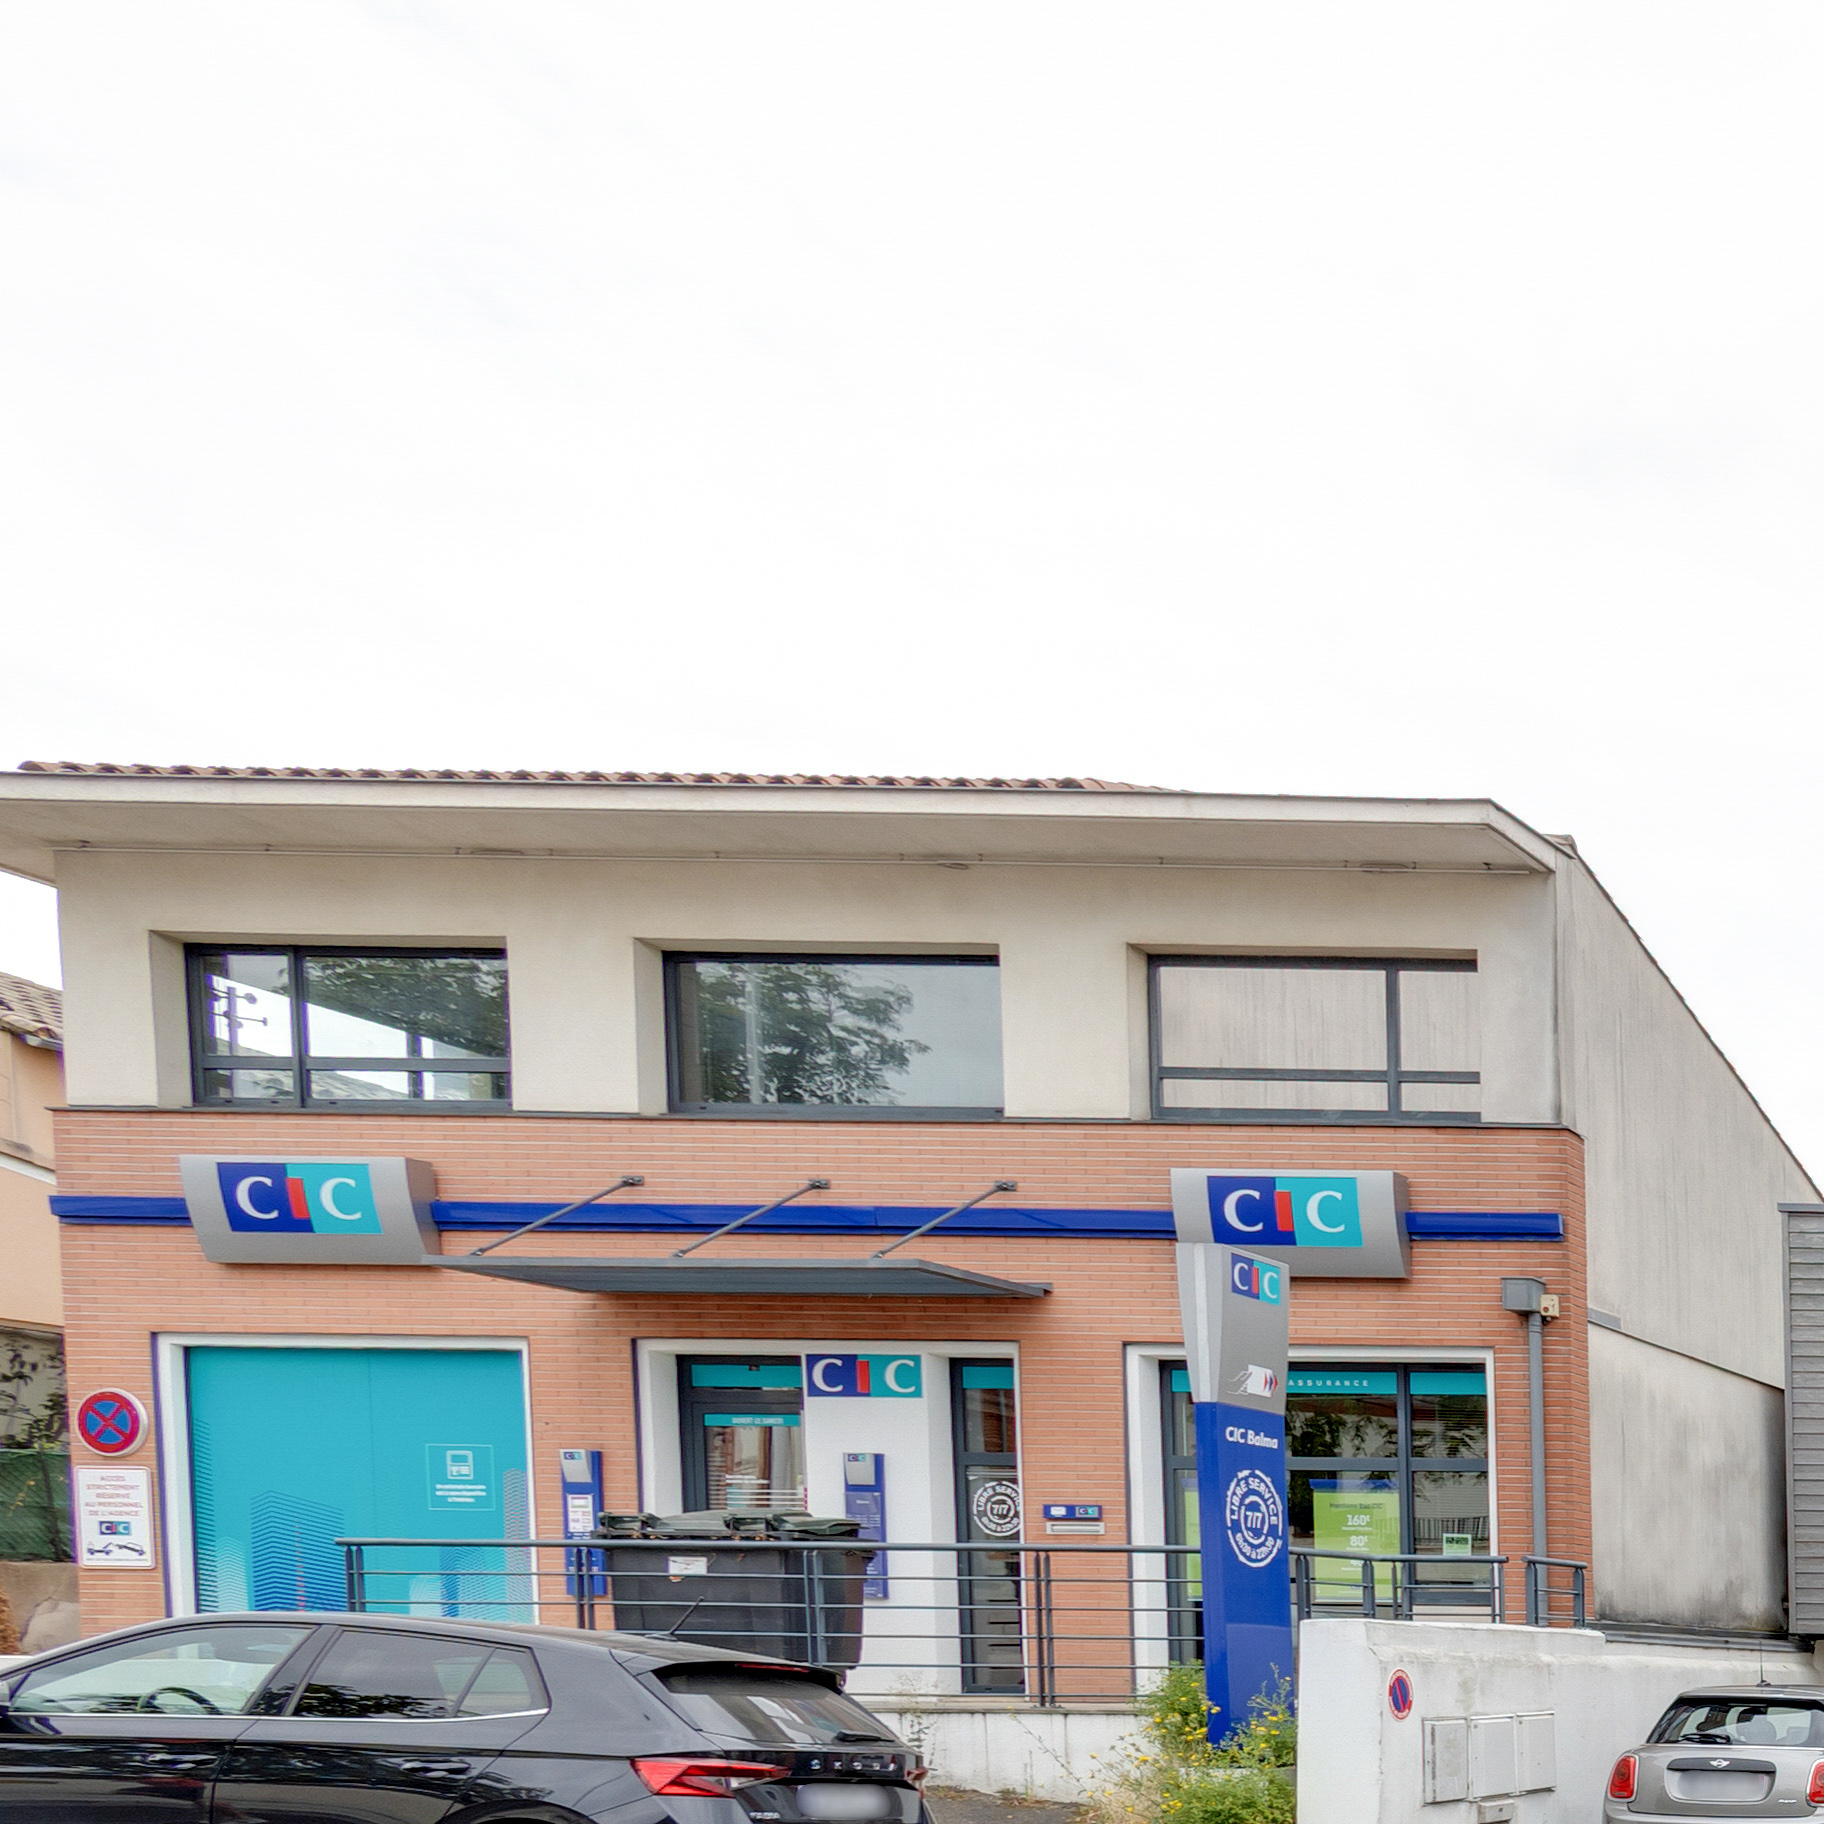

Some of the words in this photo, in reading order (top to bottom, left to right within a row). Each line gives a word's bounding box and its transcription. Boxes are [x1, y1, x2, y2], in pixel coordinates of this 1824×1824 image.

[235, 1175, 362, 1221] CIC
[1223, 1188, 1346, 1233] CIC
[1233, 1261, 1279, 1299] CIC
[811, 1357, 916, 1394] CIC
[1225, 1426, 1246, 1444] CIC
[1246, 1429, 1279, 1449] Balma
[1247, 1476, 1279, 1525] SERVICE
